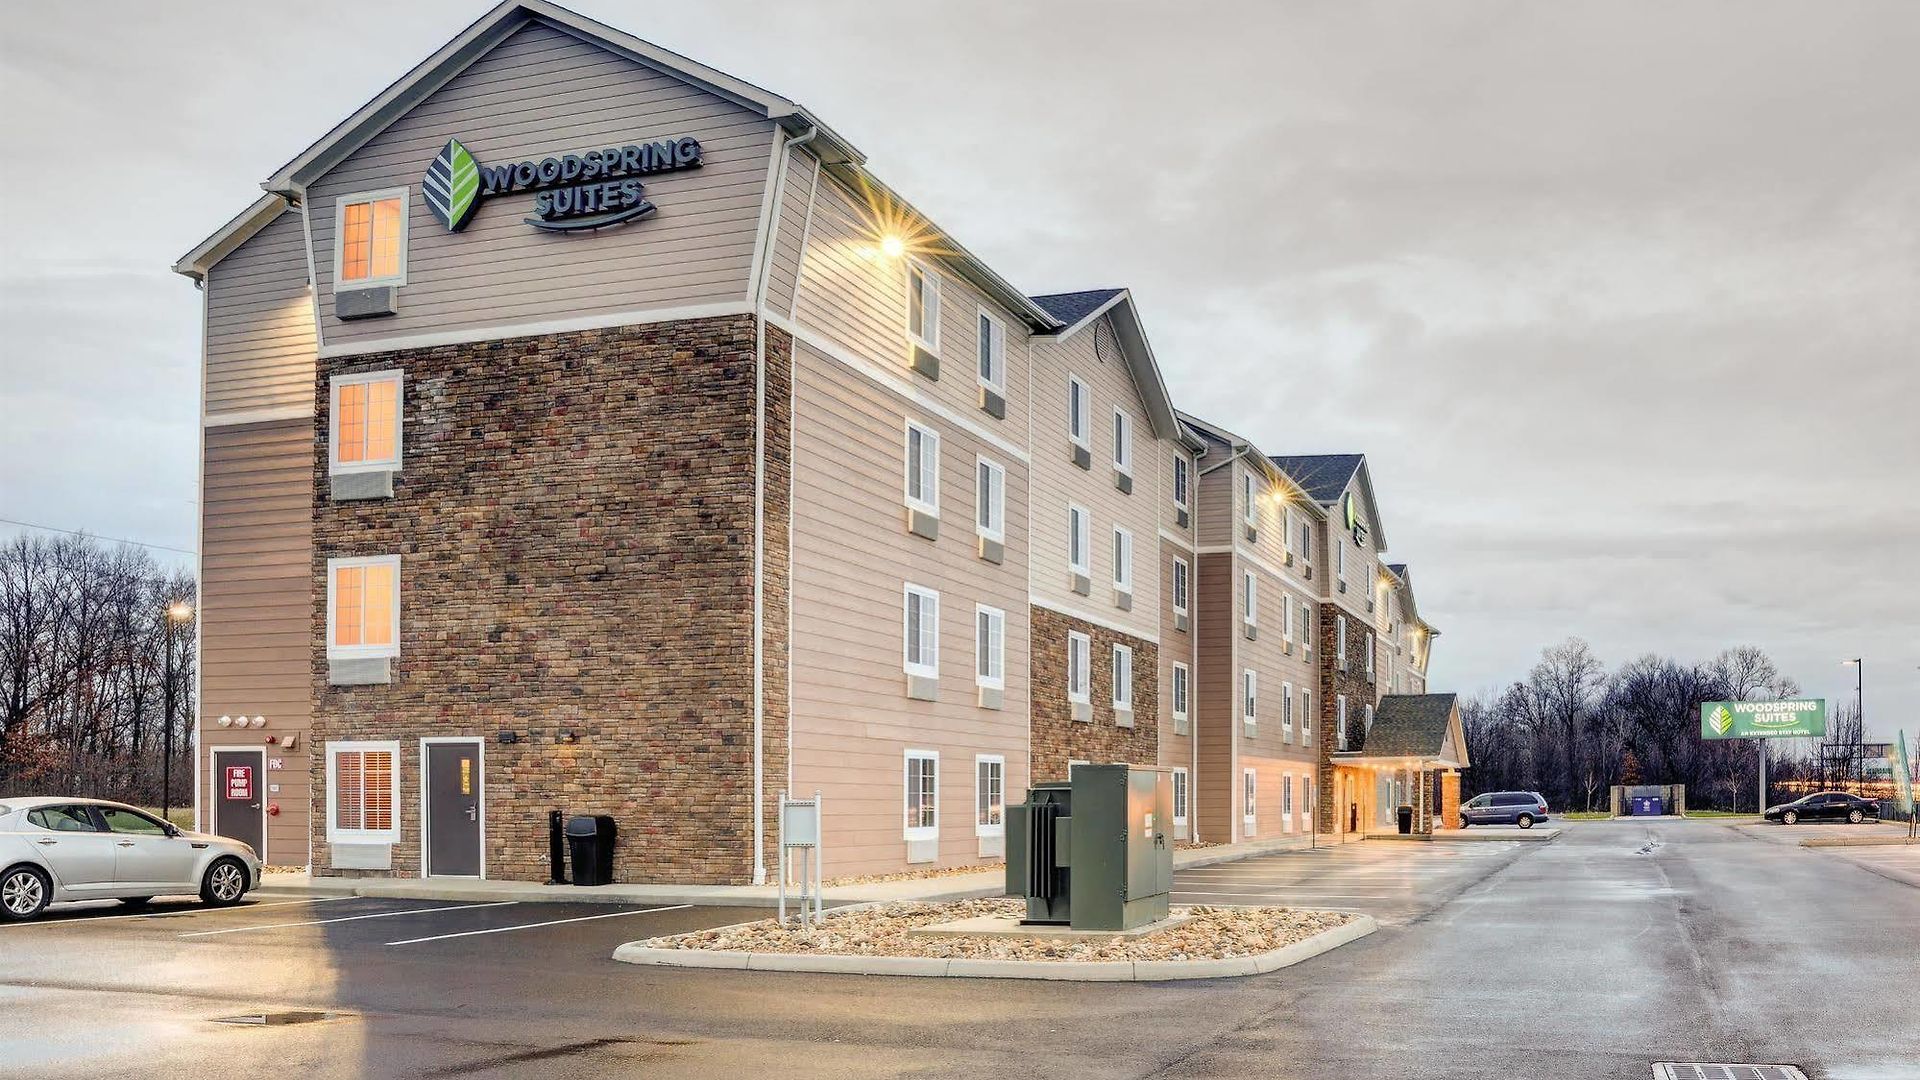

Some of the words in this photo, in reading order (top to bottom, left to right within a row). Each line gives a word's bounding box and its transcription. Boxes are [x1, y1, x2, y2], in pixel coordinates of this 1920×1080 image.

[482, 137, 702, 193] WOODSPRING
[535, 179, 644, 217] SUITES
[1734, 701, 1817, 713] WOODSPRING
[1754, 712, 1797, 723] SUITES
[233, 769, 246, 778] FIRE
